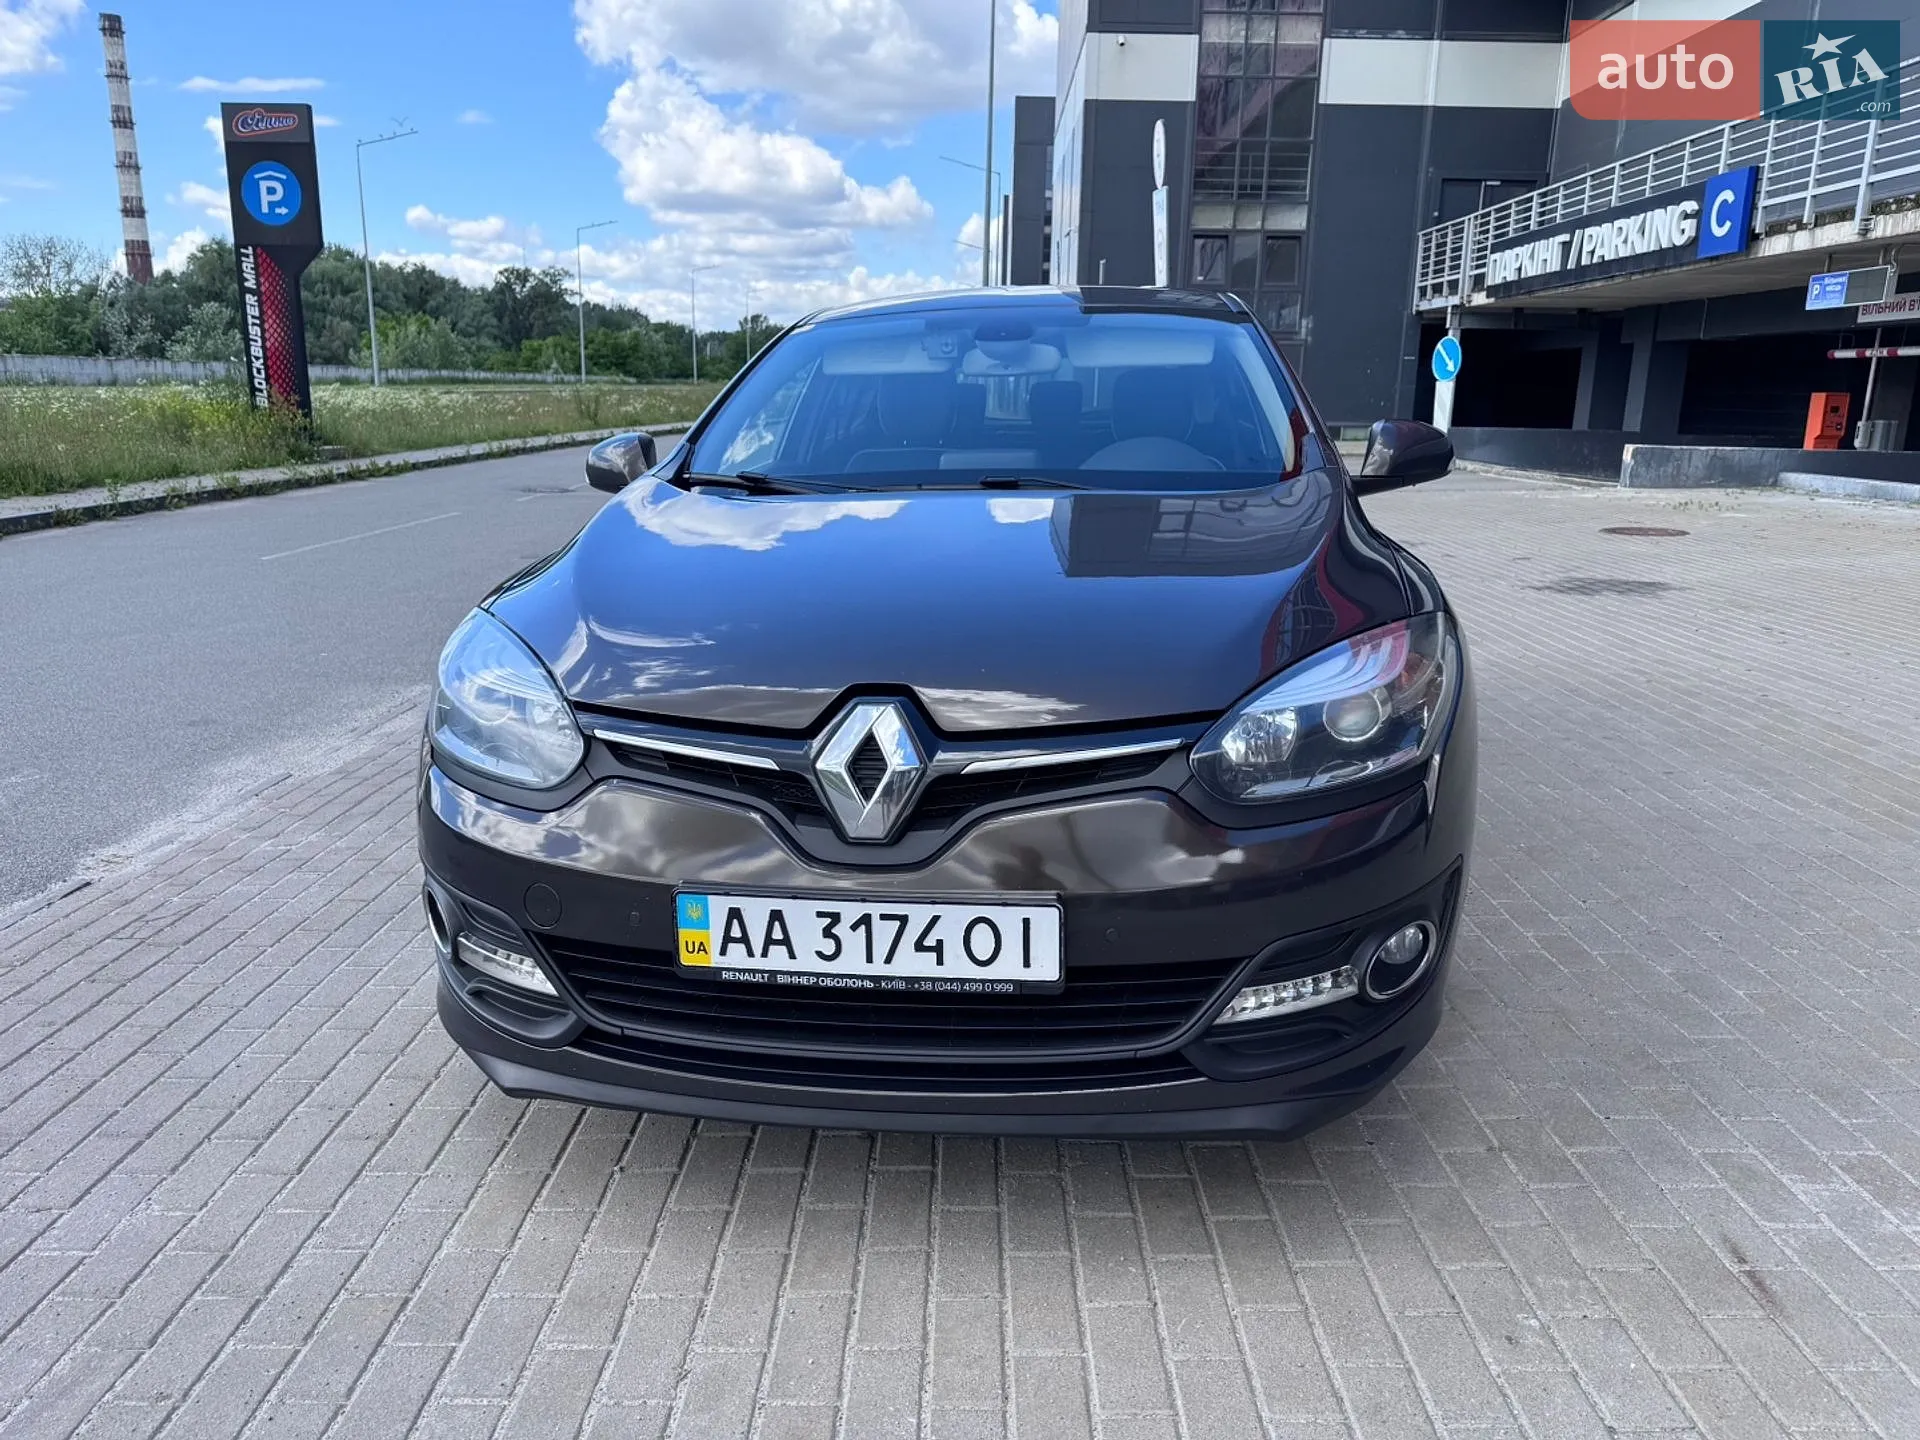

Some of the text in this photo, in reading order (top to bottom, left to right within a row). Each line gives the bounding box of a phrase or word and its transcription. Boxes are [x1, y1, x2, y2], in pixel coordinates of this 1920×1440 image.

[258, 179, 285, 214] P
[239, 245, 269, 408] BLOCKBUSTER MALL
[685, 940, 709, 956] UA
[814, 910, 944, 967] 3174
[721, 970, 769, 983] RENAULT
[777, 973, 816, 986] ВІННЕР
[818, 976, 874, 989] ОБОЛОНЬ
[881, 978, 906, 989] КИЇВ
[914, 982, 932, 991] +38
[934, 981, 961, 993] (044)
[963, 982, 983, 992] 499
[985, 982, 992, 992] 0
[994, 982, 1014, 993] 999
